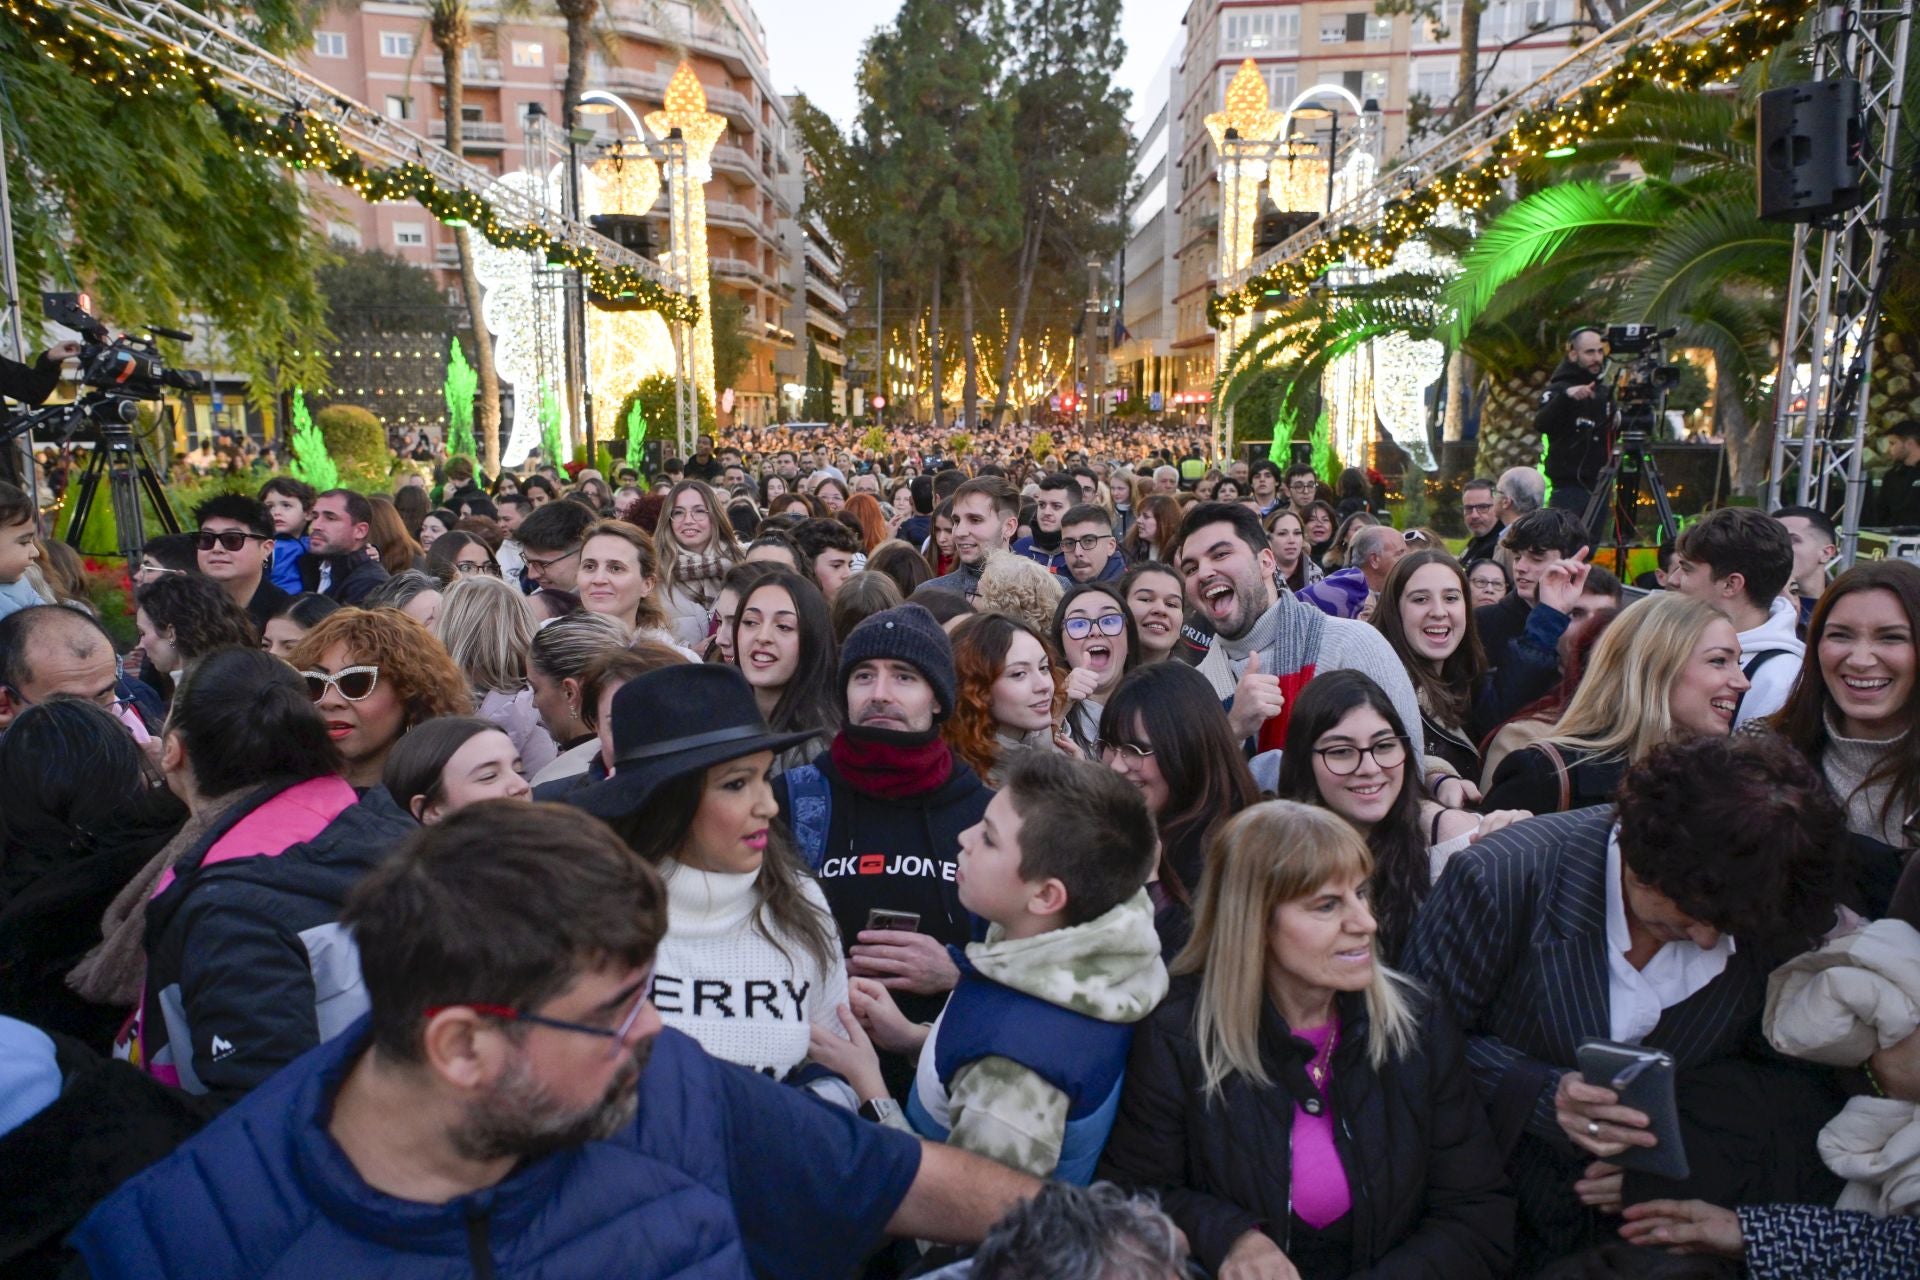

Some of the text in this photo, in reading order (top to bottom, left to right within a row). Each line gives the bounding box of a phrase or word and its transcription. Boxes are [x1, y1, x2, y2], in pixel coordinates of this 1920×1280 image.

[1181, 624, 1213, 647] PRIM
[819, 855, 957, 881] CK JONE
[647, 974, 810, 1021] ERRY
